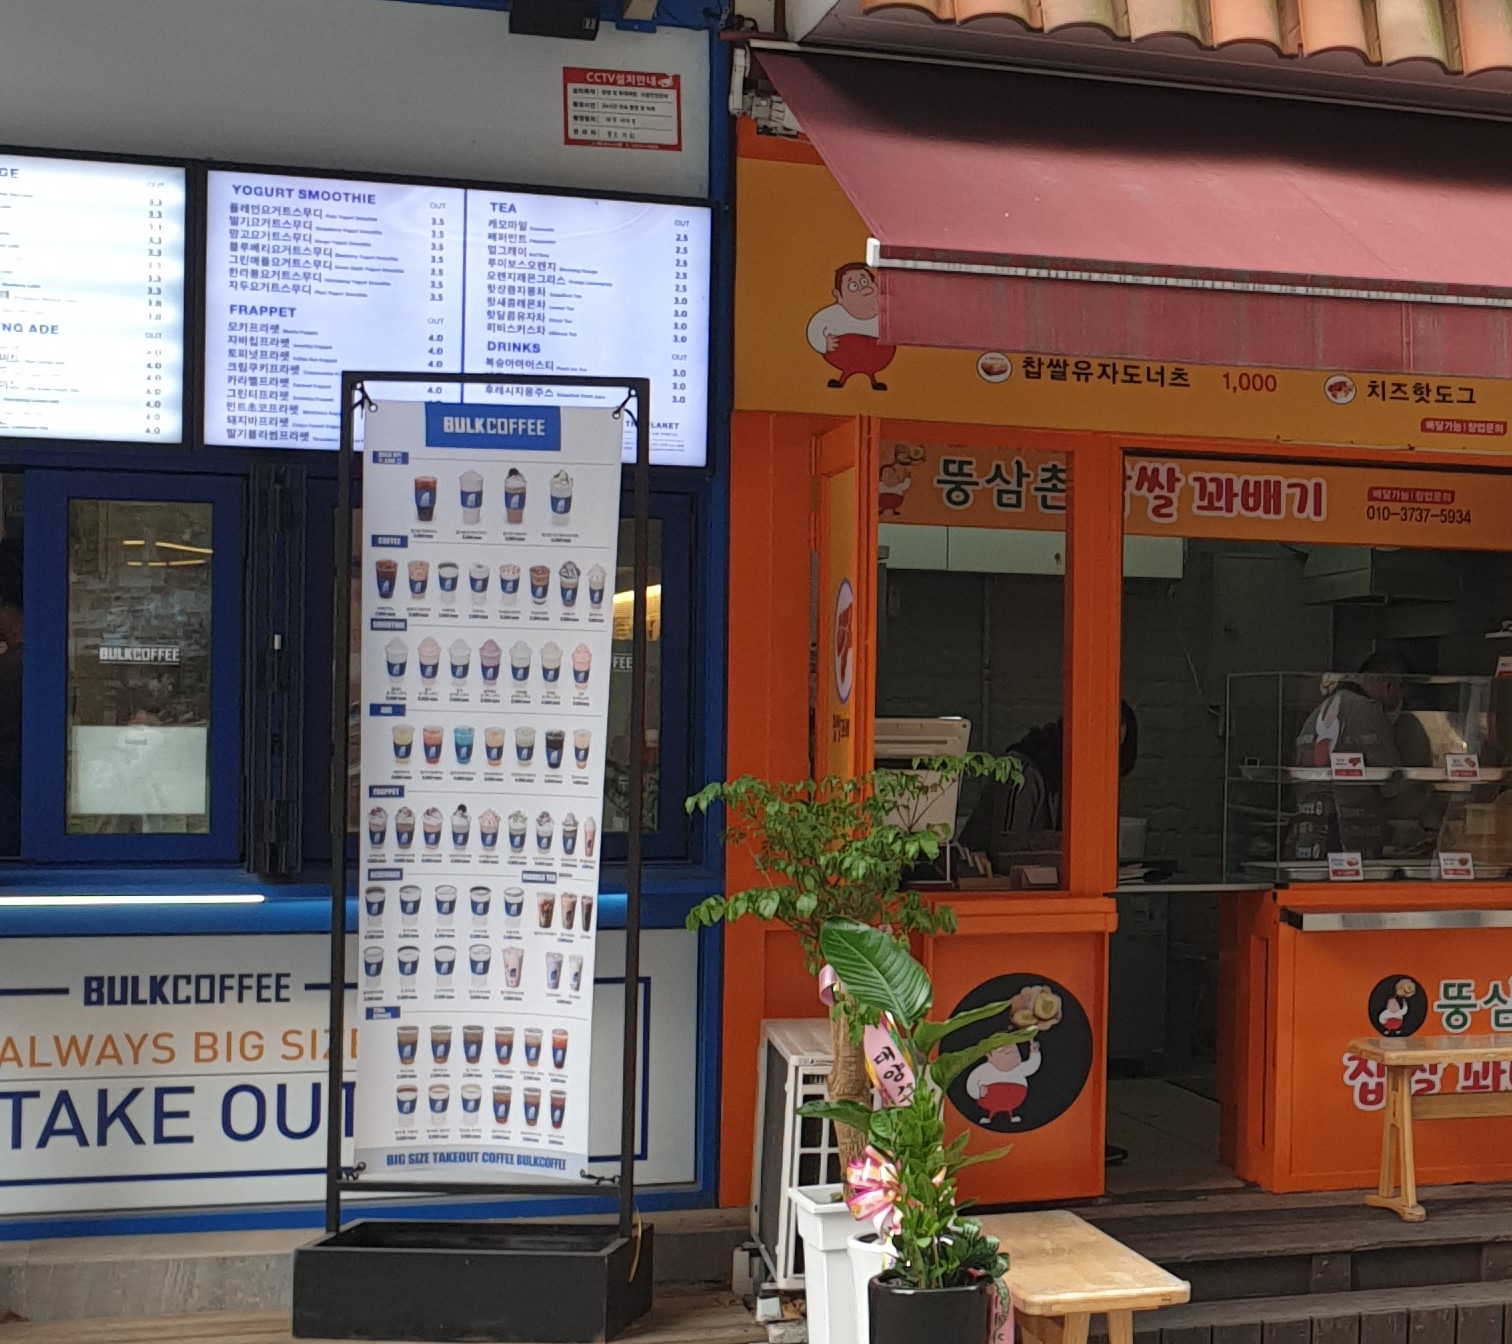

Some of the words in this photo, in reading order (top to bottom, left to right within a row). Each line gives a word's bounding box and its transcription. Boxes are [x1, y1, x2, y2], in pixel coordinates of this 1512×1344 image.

[586, 72, 656, 86] CCTV설치안내
[232, 184, 295, 199] YOGURT
[298, 189, 376, 205] SMOOTHIE
[490, 202, 517, 213] TEA
[230, 305, 296, 318] FRAPPET
[29, 325, 59, 334] ADE
[428, 334, 443, 342] 4.0
[428, 347, 443, 355] 4.0
[487, 341, 541, 353] DRINKS
[428, 360, 443, 368] 4.0
[1022, 355, 1192, 389] 찹쌀유자도너츠
[1221, 371, 1277, 394] 1,000
[428, 386, 442, 395] 4.0
[1366, 380, 1477, 406] 치즈핫도그
[443, 416, 546, 436] BULKCOFFEE
[651, 422, 679, 430] LANET
[934, 457, 1067, 513] 뚱삼촌
[1123, 461, 1183, 523] 쌀
[1191, 470, 1328, 523] 꽈배기
[1366, 505, 1472, 525] 010-3737-5934
[99, 646, 180, 662] BULKCOFFEE
[83, 973, 291, 1007] BULKCOFFEE
[0, 1031, 176, 1068] ALWAYS
[193, 1030, 264, 1064] BIG
[281, 1028, 358, 1061] SI
[0, 1085, 195, 1151] TAKE
[387, 1154, 405, 1166] BIG
[409, 1154, 429, 1164] SIZE
[433, 1152, 479, 1163] TAKEOUT
[482, 1152, 514, 1165] COFFEE
[517, 1154, 567, 1170] BULKCOFFEE
